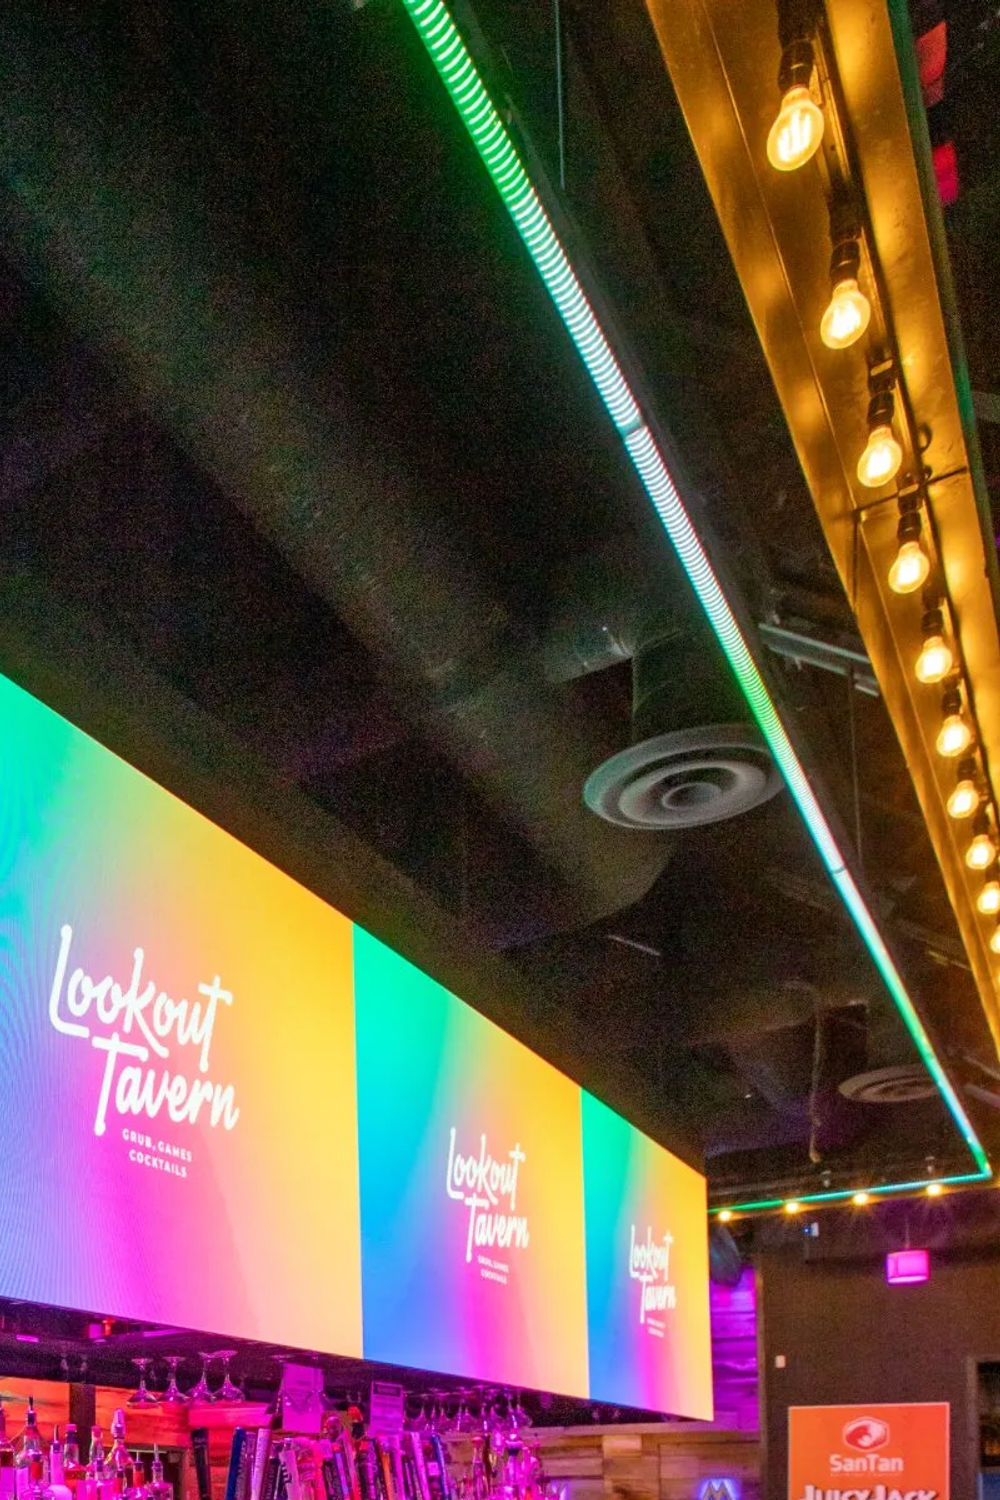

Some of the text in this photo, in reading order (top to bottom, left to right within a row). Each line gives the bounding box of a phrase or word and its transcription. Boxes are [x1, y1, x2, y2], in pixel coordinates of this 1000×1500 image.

[49, 924, 234, 1073] Lookout
[91, 1032, 240, 1136] Tavern
[129, 1149, 187, 1178] COCKTAILS
[157, 1140, 192, 1163] GAMES
[447, 1127, 525, 1211] Lookout
[464, 1193, 530, 1263] Tavern
[629, 1224, 674, 1281] Lookout
[638, 1271, 676, 1324] Tavern
[829, 1454, 904, 1472] SanTan
